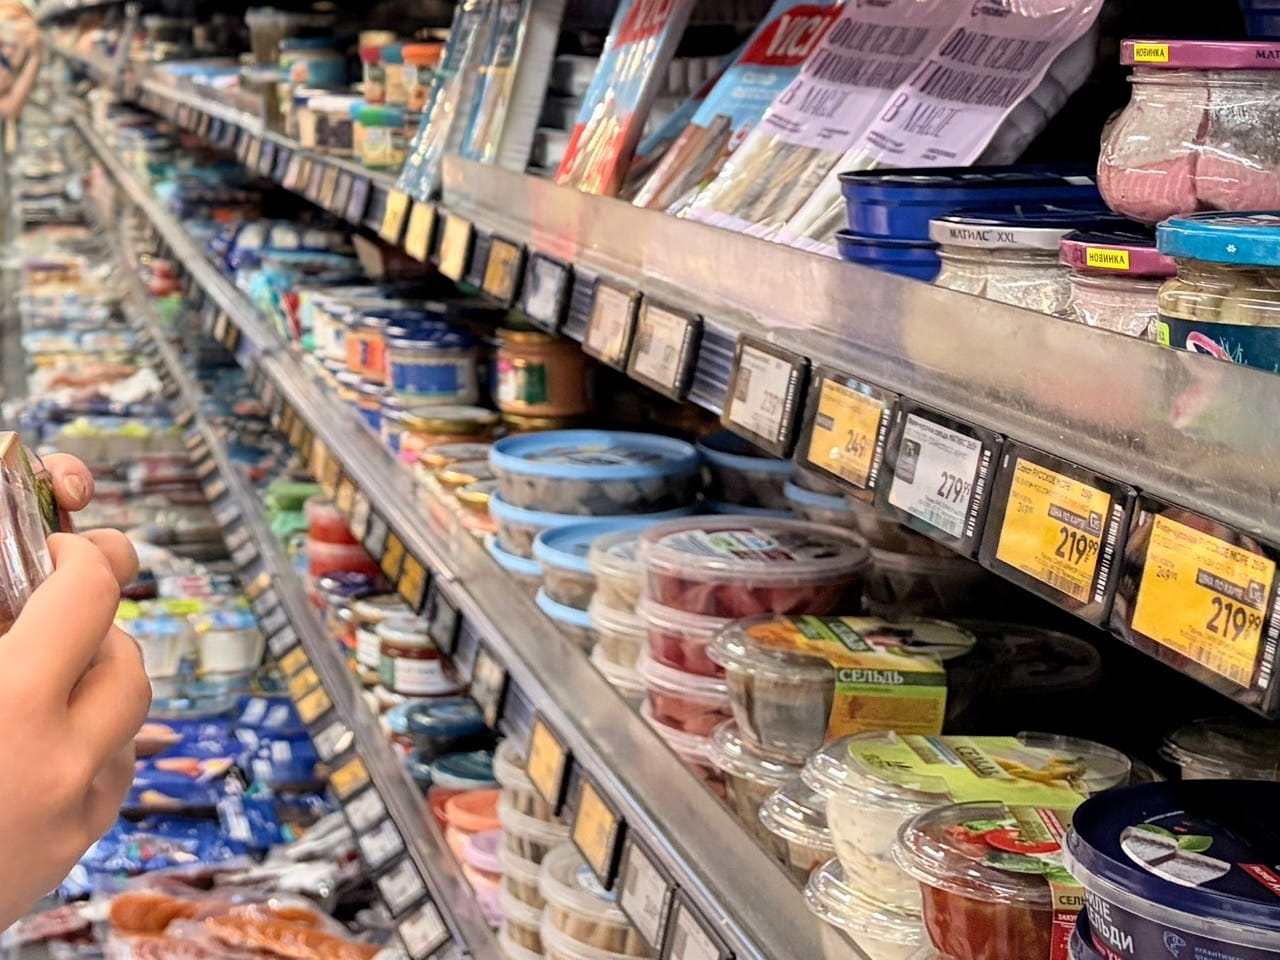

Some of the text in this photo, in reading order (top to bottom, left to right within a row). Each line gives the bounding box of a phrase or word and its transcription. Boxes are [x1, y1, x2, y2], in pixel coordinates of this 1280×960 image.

[1136, 48, 1165, 58] НОВИНКА
[881, 93, 909, 123] В
[997, 231, 1018, 244] XXL
[1089, 253, 1126, 265] НОВИНКА
[937, 471, 963, 503] 279
[1055, 526, 1088, 565] 219
[1206, 596, 1247, 641] 219
[839, 669, 905, 686] СЕЛЬДЬ
[1086, 889, 1112, 922] ИЛЕ
[1087, 908, 1135, 954] ЕЛЬДИ
